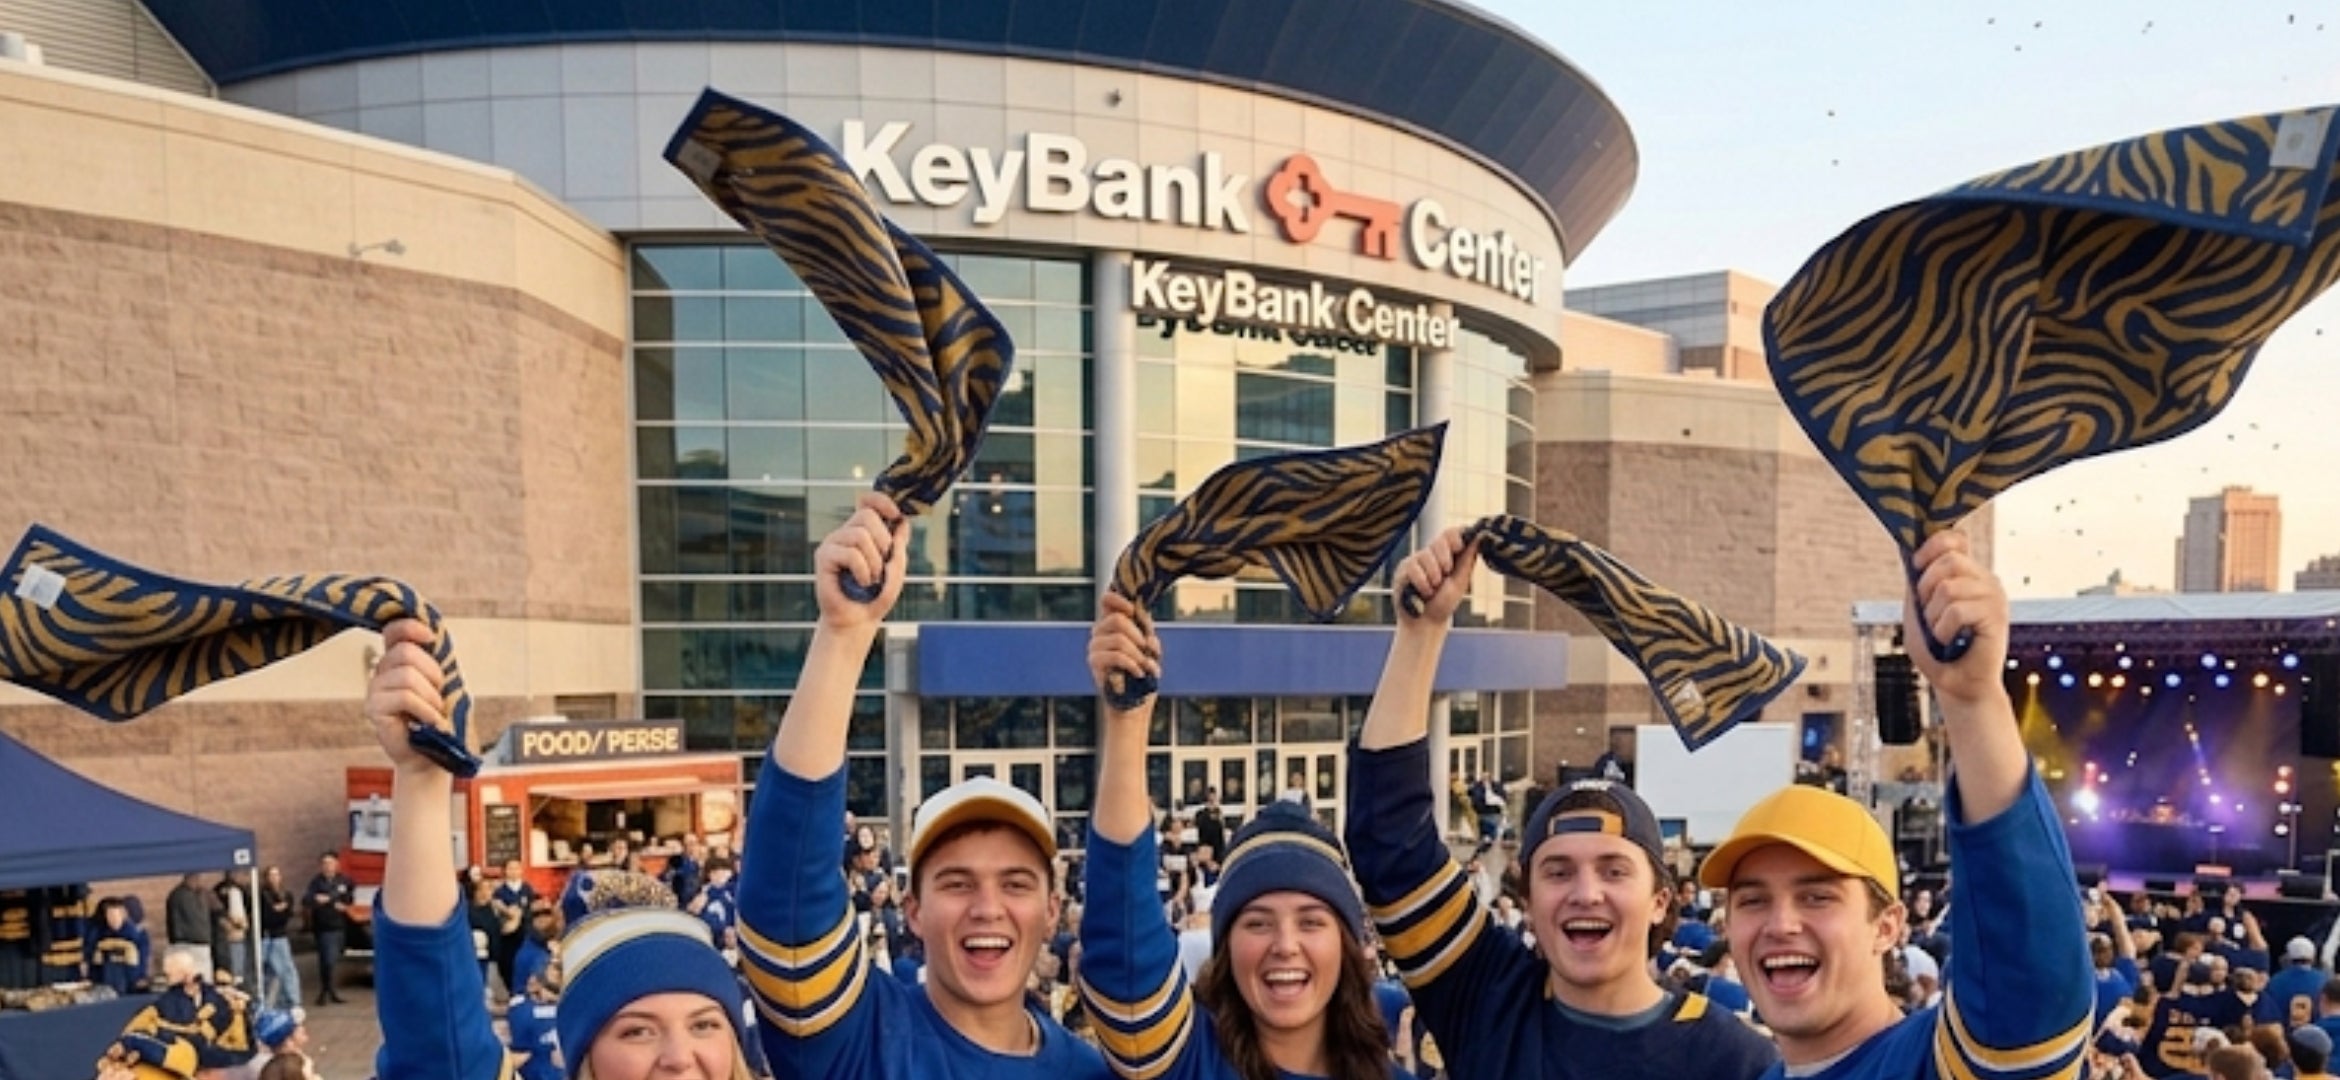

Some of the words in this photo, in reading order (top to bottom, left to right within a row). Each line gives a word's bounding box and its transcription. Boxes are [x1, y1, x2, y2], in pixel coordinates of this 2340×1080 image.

[842, 119, 1250, 234] KeyBank
[1410, 198, 1546, 303] Center
[1132, 259, 1337, 329] KeyBank
[1346, 288, 1460, 348] Center
[606, 726, 679, 754] PERSE
